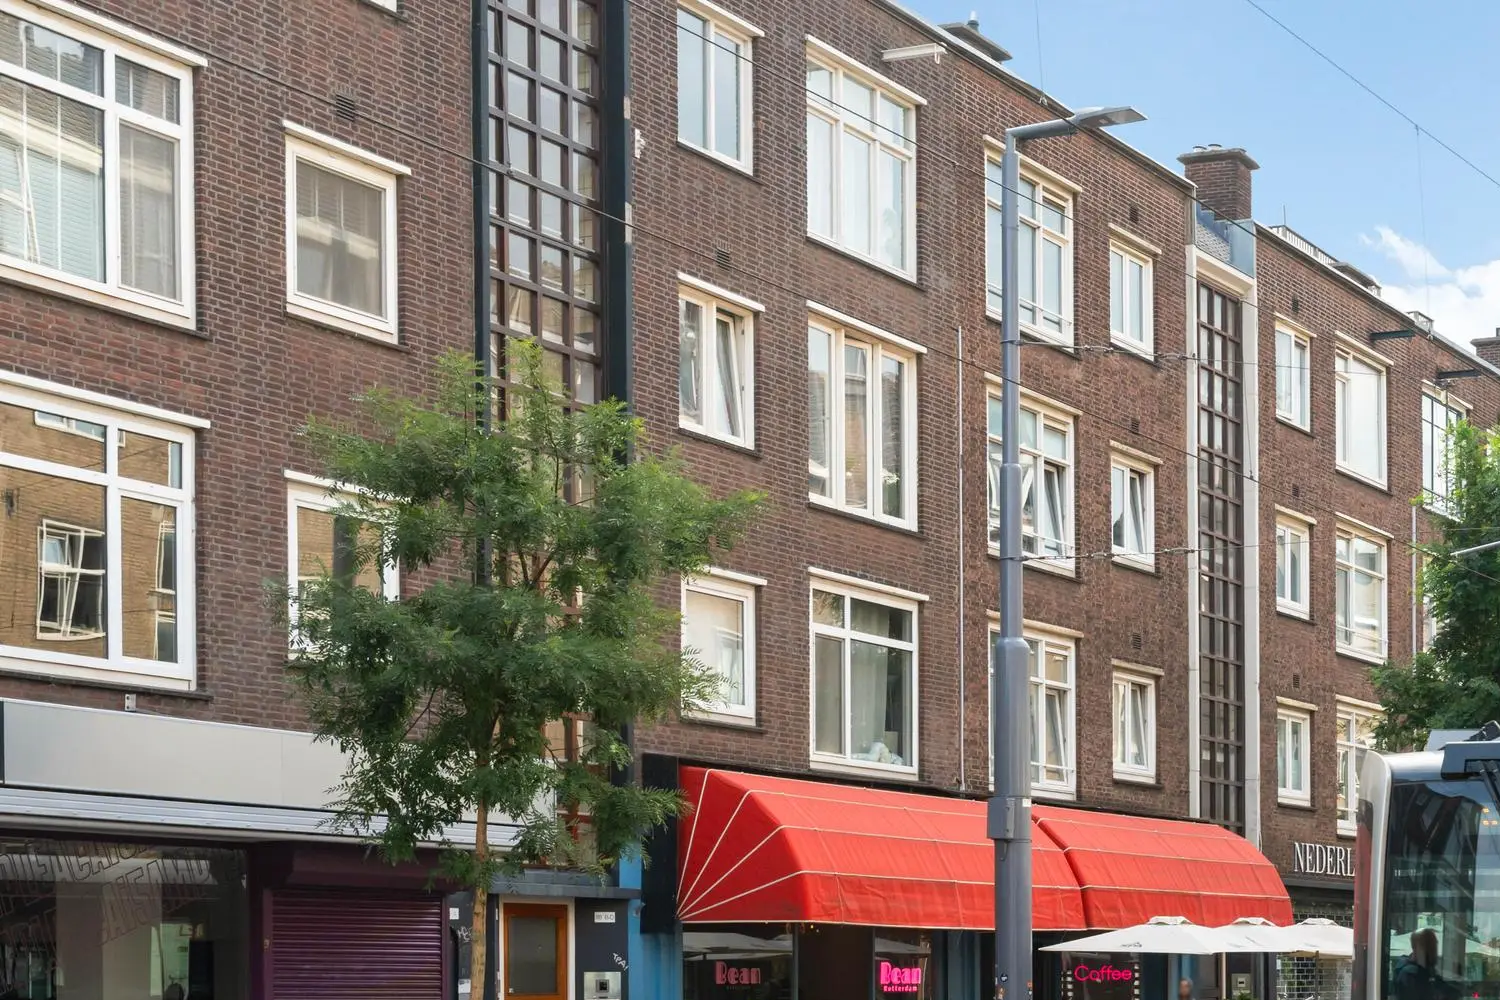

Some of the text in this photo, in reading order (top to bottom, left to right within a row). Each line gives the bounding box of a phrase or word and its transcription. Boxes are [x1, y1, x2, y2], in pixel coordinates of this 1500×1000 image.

[1293, 842, 1357, 877] NEDERL
[715, 961, 761, 985] Bean
[880, 961, 922, 985] Bean
[1074, 964, 1133, 982] Coffee
